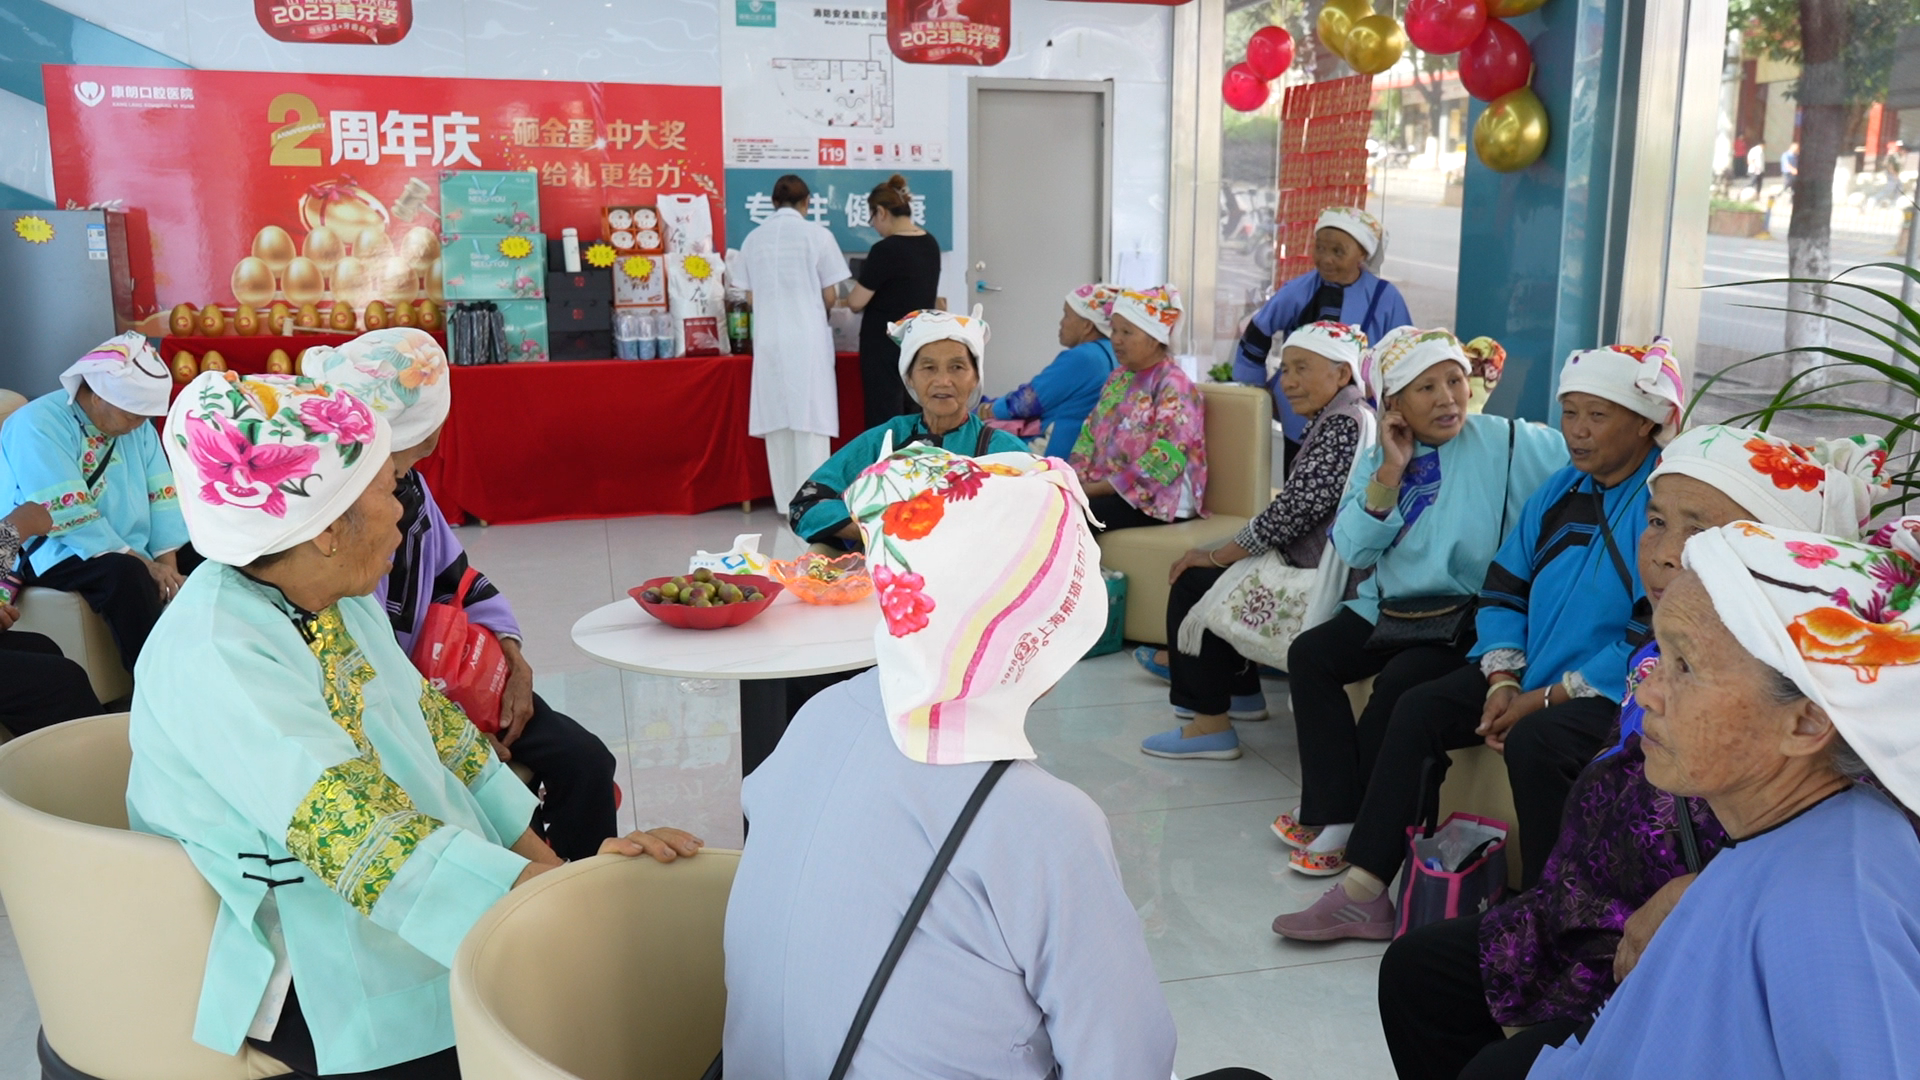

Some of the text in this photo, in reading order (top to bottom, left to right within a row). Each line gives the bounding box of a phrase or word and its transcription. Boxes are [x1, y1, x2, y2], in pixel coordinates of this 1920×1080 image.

[272, 4, 398, 25] 2023美牙季
[900, 30, 1000, 49] 2023美牙季
[276, 122, 326, 140] ANNIVERSARY
[512, 117, 688, 151] 砸金蛋 中大奖
[820, 147, 844, 162] 119
[542, 161, 682, 188] 给礼更给力
